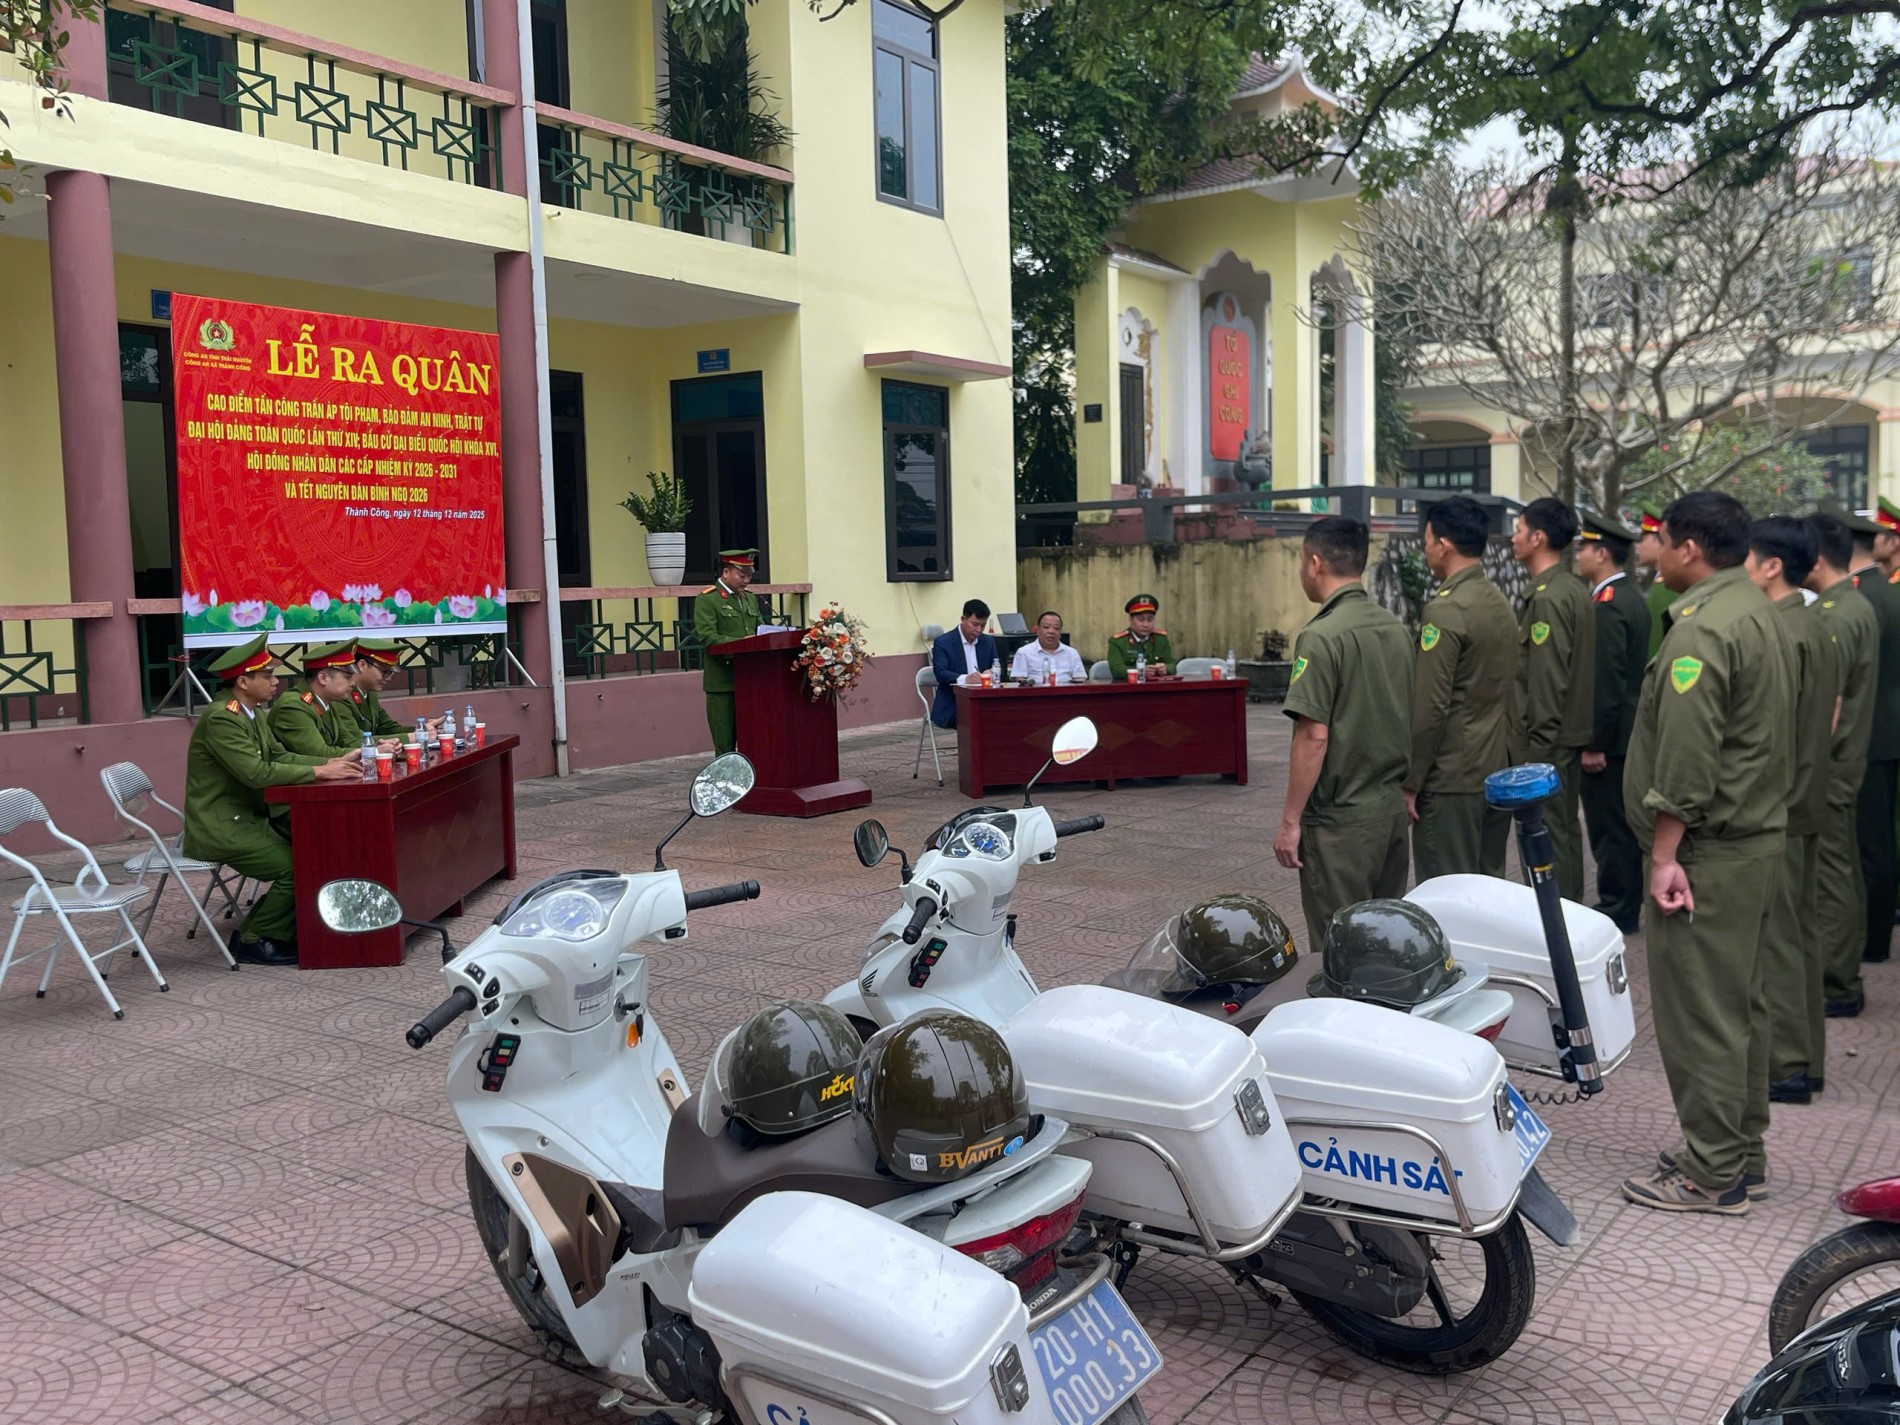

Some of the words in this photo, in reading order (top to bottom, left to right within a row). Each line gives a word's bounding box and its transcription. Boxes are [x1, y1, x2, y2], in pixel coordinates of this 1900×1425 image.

[266, 323, 320, 379] LỄ
[330, 347, 384, 385] RA
[392, 350, 491, 396] QUÂN
[207, 393, 227, 411] CAO
[228, 390, 253, 413] ĐIỂM
[254, 392, 273, 415] TẤN
[275, 396, 300, 417] CÔNG
[301, 397, 324, 418] TRẤN
[326, 400, 338, 420] ÁP
[339, 402, 353, 424] TỘI
[355, 406, 381, 426] PHẠM,
[382, 404, 399, 425] BẢO
[400, 405, 419, 426] ĐẢM
[420, 411, 432, 427] AN
[432, 412, 454, 429] NINH,
[454, 412, 473, 433] TRẬT
[473, 415, 484, 434] TỰ
[188, 420, 205, 442] ĐẠI
[207, 419, 224, 443] HỘI
[226, 418, 253, 441] ĐẢNG
[255, 422, 280, 443] TOÀN
[281, 422, 306, 446] QUỐC
[307, 424, 325, 446] LẦN
[327, 427, 343, 447] THỨ
[380, 429, 392, 450] CỬ
[393, 434, 407, 454] ĐẠI
[408, 431, 427, 452] BIỂU
[428, 433, 449, 454] QUỐC
[450, 436, 463, 458] HỘI
[485, 441, 499, 458] XVI,
[247, 449, 263, 473] HỘI
[265, 449, 290, 471] ĐỒNG
[292, 452, 317, 472] NHÂN
[318, 453, 337, 473] DÂN
[338, 454, 355, 474] CÁC
[357, 453, 374, 475] CẤP
[375, 457, 401, 479] NHIỆM
[415, 462, 434, 478] 2026
[440, 463, 458, 479] 2031
[284, 479, 298, 499] VÀ
[298, 478, 314, 499] TẾT
[315, 481, 350, 500] NGUYÊN
[351, 482, 369, 501] ĐÁN
[370, 482, 390, 502] BÍNH
[391, 486, 408, 505] NGỌ
[409, 486, 428, 503] 2026
[345, 506, 369, 517] Thành
[370, 507, 392, 519] Công,
[393, 508, 412, 519] ngày
[413, 508, 421, 518] 12
[422, 508, 443, 520] tháng
[444, 509, 453, 518] 12
[453, 510, 468, 519] năm
[469, 510, 485, 519] 2025
[1298, 1136, 1398, 1186] CẢNH
[1028, 1287, 1058, 1313] ONDA
[1033, 1293, 1116, 1381] 20-H1
[1053, 1329, 1151, 1425] 000.33
